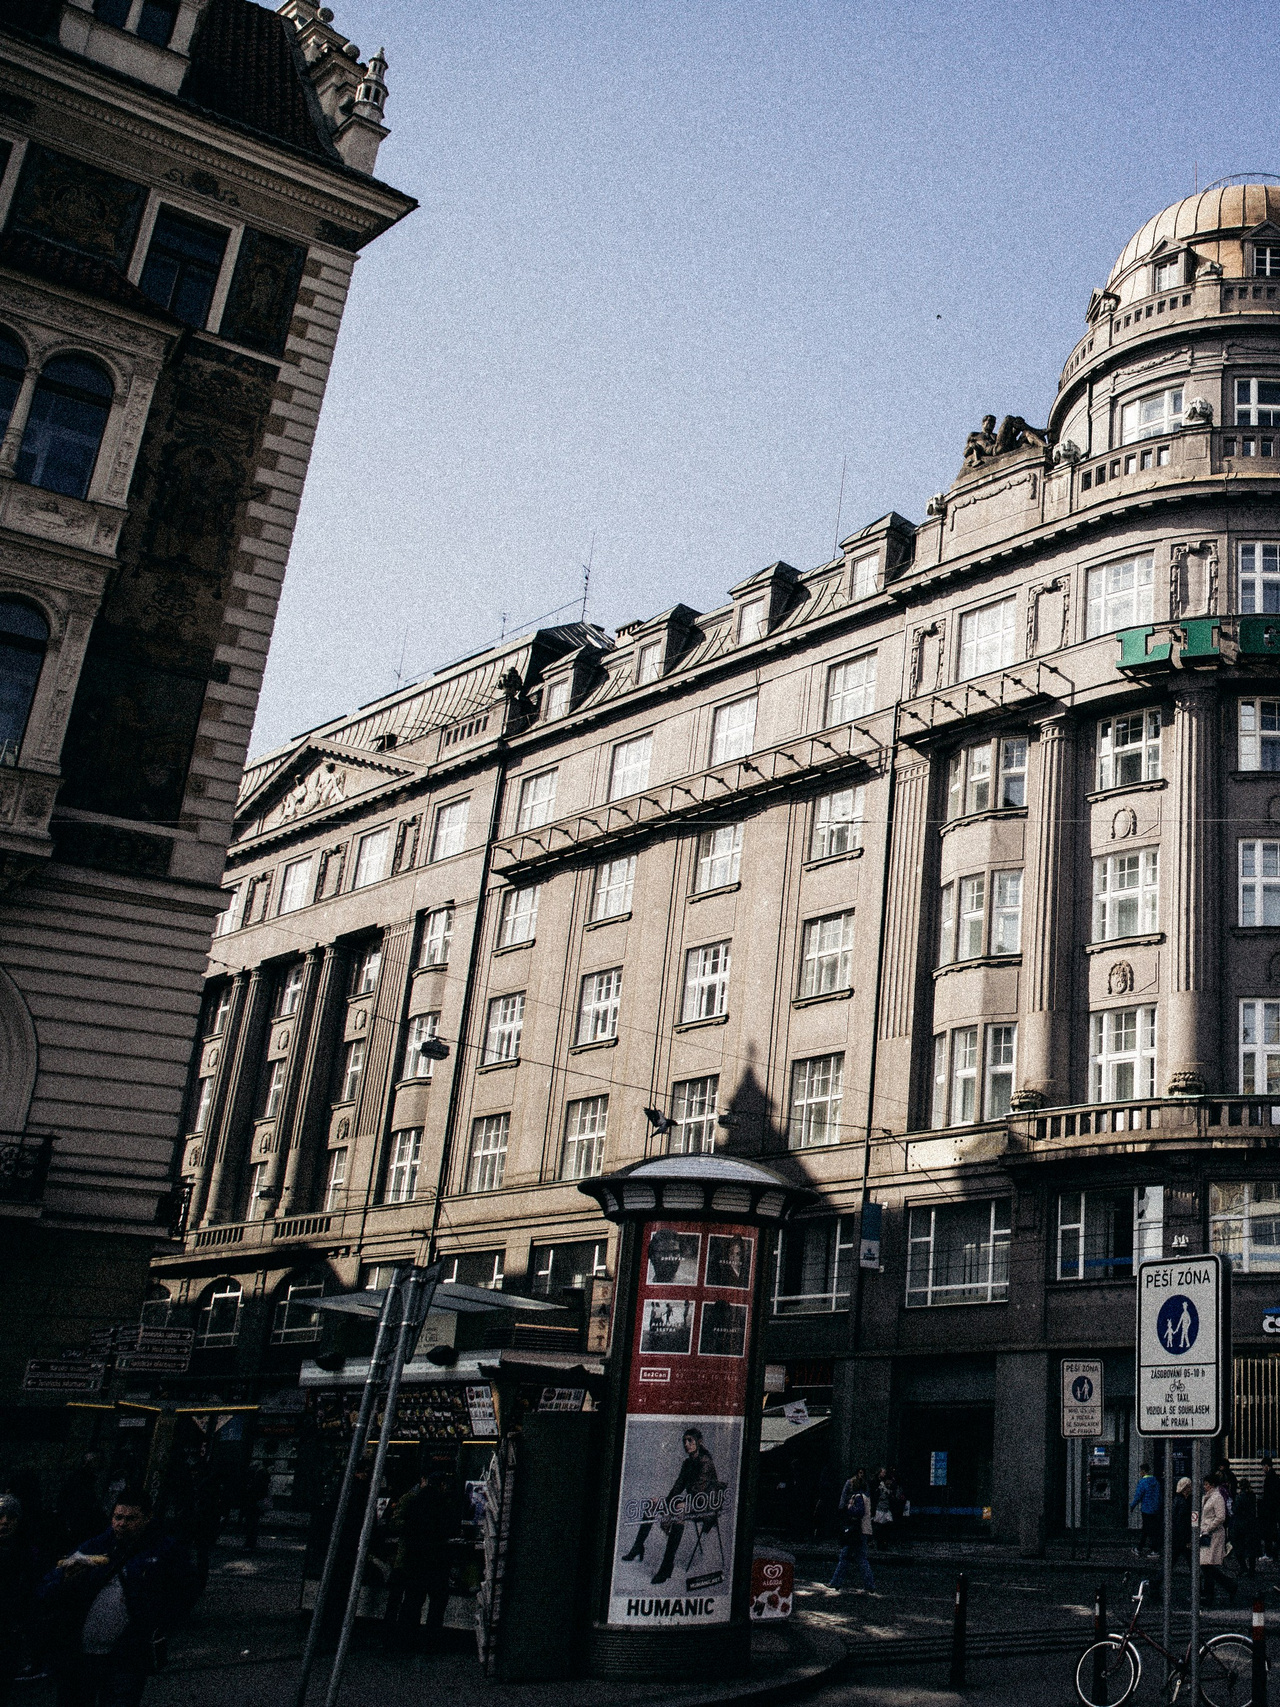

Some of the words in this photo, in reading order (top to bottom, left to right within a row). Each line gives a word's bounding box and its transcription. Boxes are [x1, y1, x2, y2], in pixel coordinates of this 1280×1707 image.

[1146, 1268, 1174, 1288] PĚŠÍ
[1178, 1267, 1211, 1286] ZÓNA
[1151, 1367, 1182, 1379] ZÁSOBOVÁNÍ
[1201, 1368, 1206, 1377] h
[1146, 1405, 1167, 1415] VOZIDLA
[1169, 1405, 1176, 1414] SE
[1178, 1404, 1210, 1414] SOUHLASEM
[1161, 1416, 1169, 1427] MČ
[1171, 1418, 1188, 1427] PRAHA
[626, 1487, 734, 1520] GRACIOUS
[627, 1599, 715, 1616] HUMANIC
